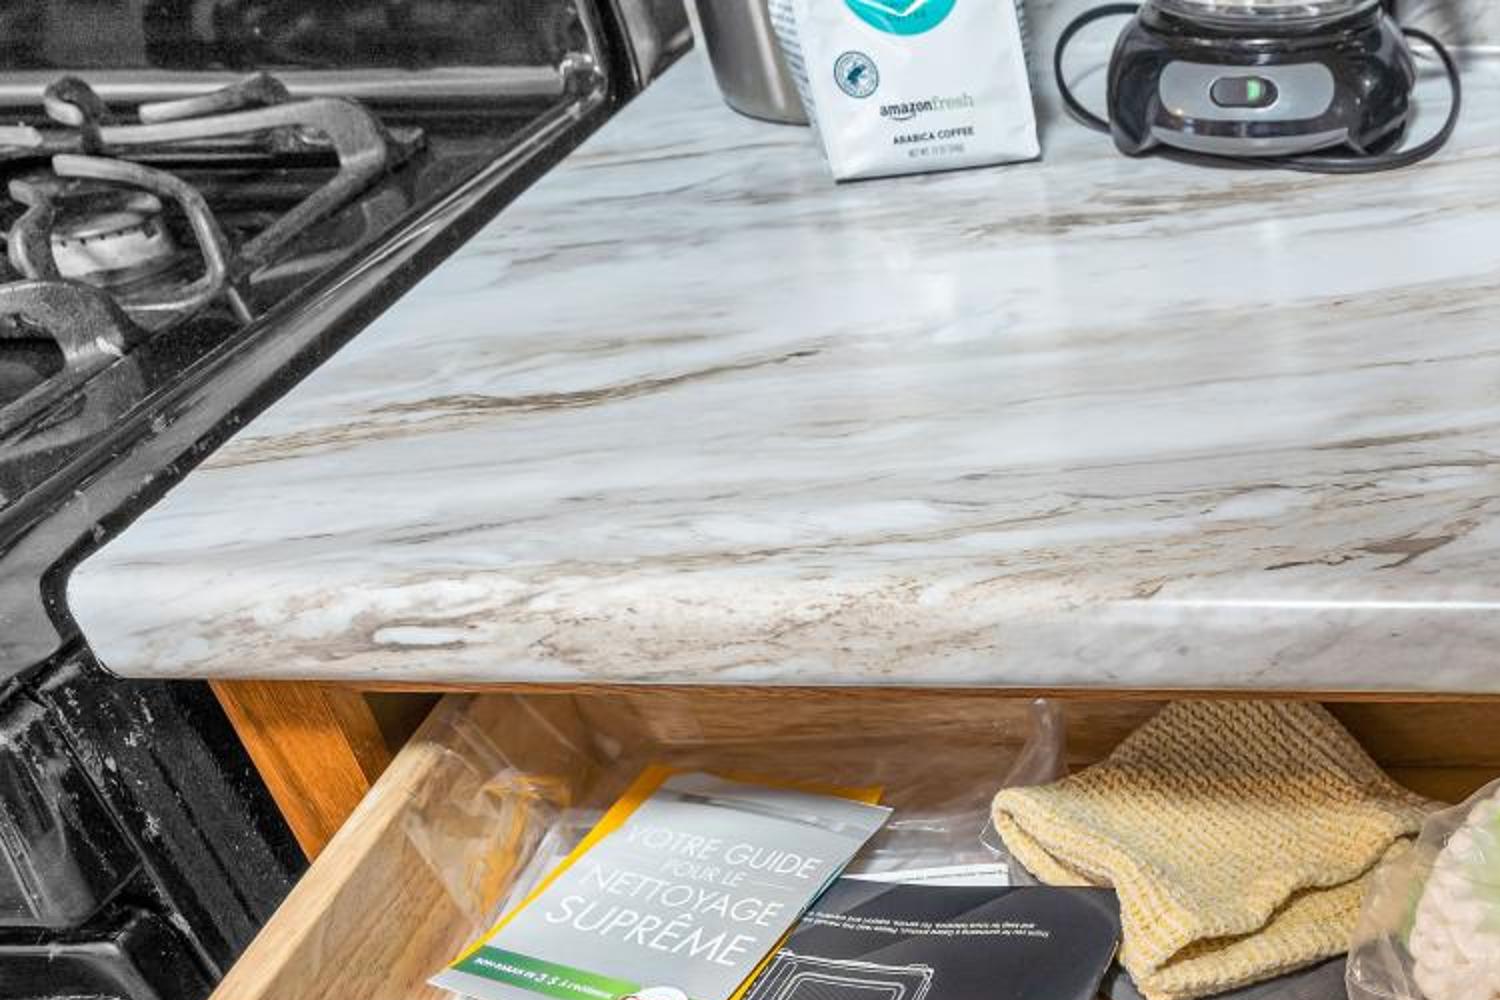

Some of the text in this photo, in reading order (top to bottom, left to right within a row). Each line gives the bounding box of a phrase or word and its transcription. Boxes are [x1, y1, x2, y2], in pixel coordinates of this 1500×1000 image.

[880, 92, 974, 120] amazonfresh
[893, 126, 974, 145] ARABICA COFFEE
[628, 823, 822, 879] VOTRE GUIDE
[659, 857, 748, 887] POUR LE
[582, 865, 785, 927] NETTOYAGE
[545, 895, 757, 967] SUPRÊME
